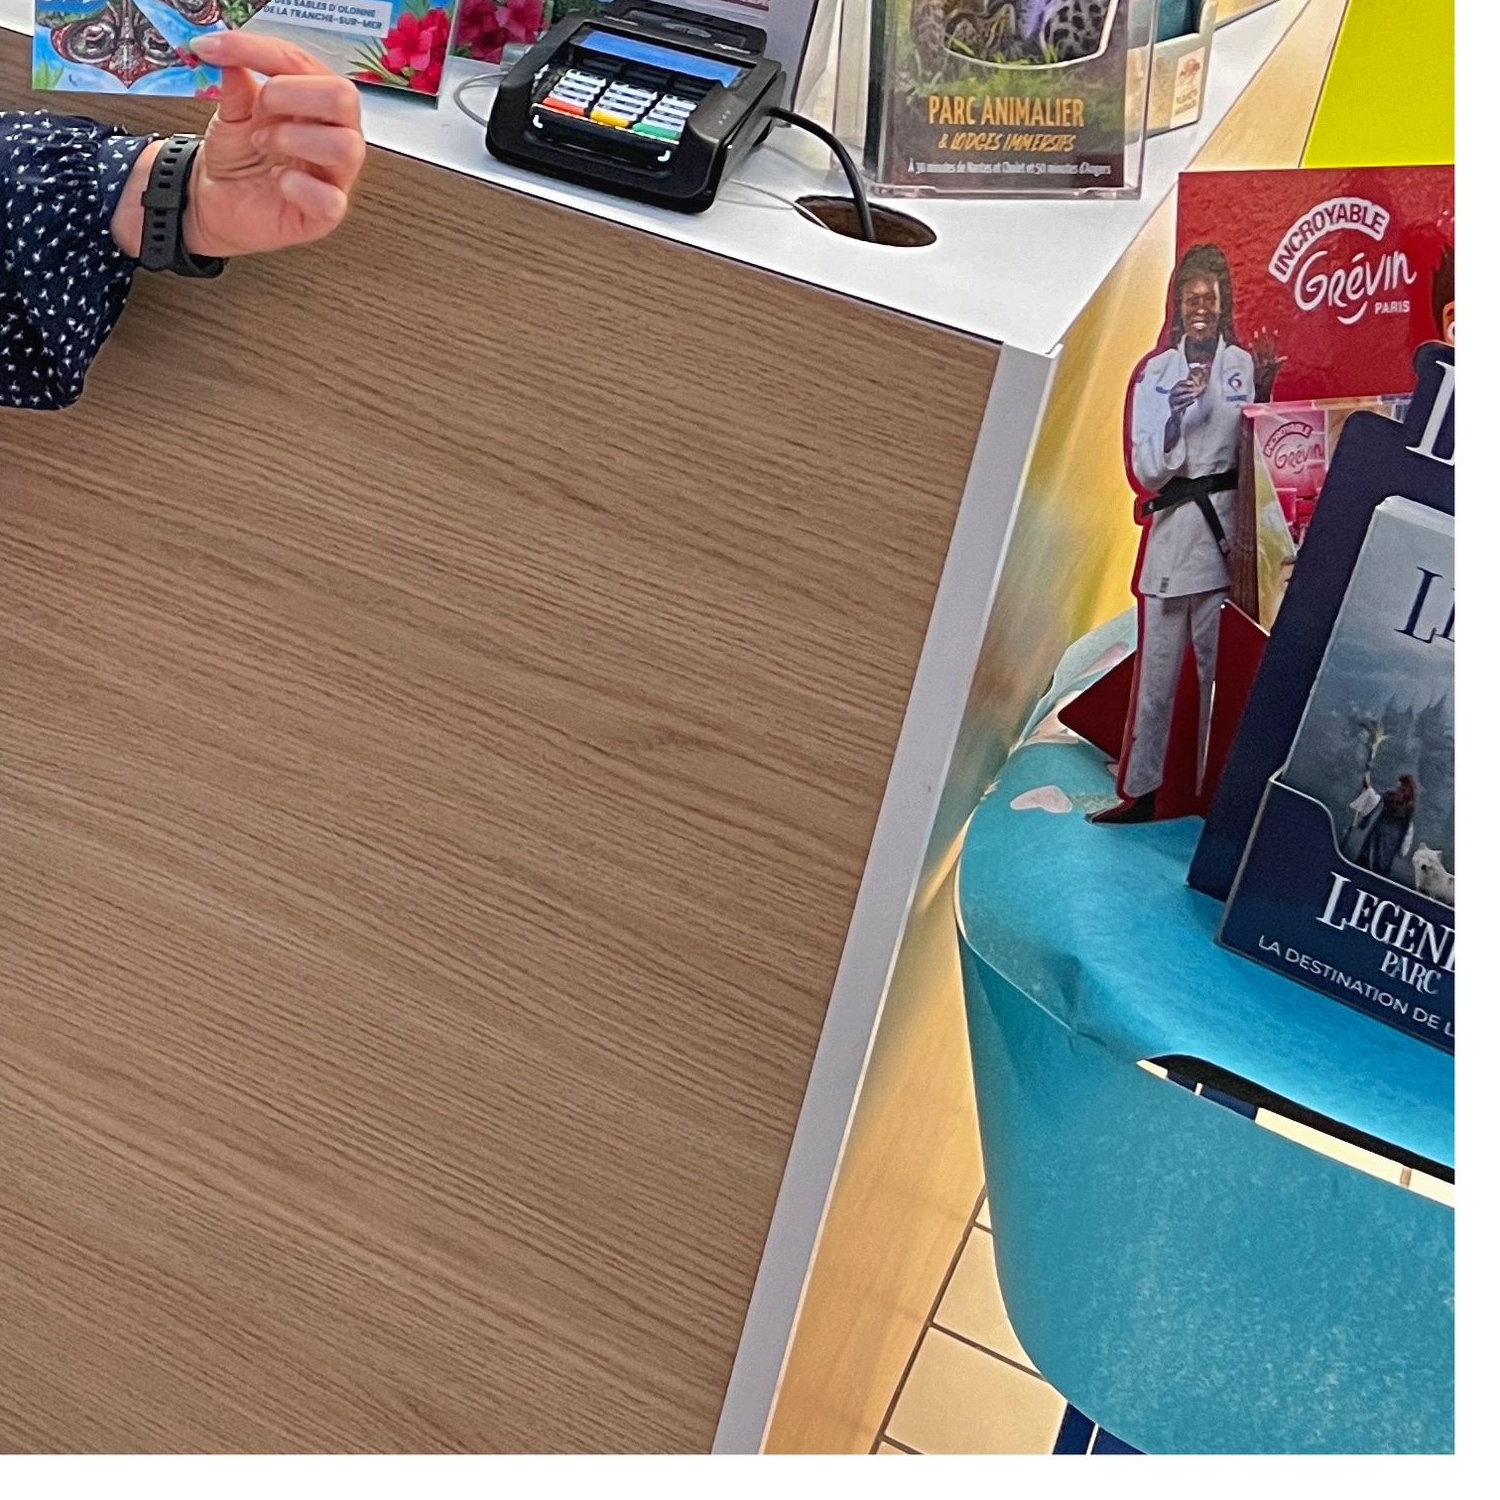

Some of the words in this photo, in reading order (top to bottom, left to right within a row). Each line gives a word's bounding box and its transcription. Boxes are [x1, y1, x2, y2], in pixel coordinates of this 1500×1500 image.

[276, 7, 288, 16] LA
[290, 8, 382, 29] TRANCHE-SUR-MER
[928, 96, 976, 125] PARC
[981, 97, 1084, 127] ANIMALIER
[938, 134, 948, 149] &
[950, 133, 1002, 151] LODGES
[1272, 202, 1386, 276] INCROYABLE
[1374, 299, 1410, 315] PARIS
[1258, 934, 1281, 957] LA
[1284, 947, 1409, 1015] DESTINATION
[1412, 1007, 1441, 1031] DE
[1380, 950, 1442, 995] PARC
